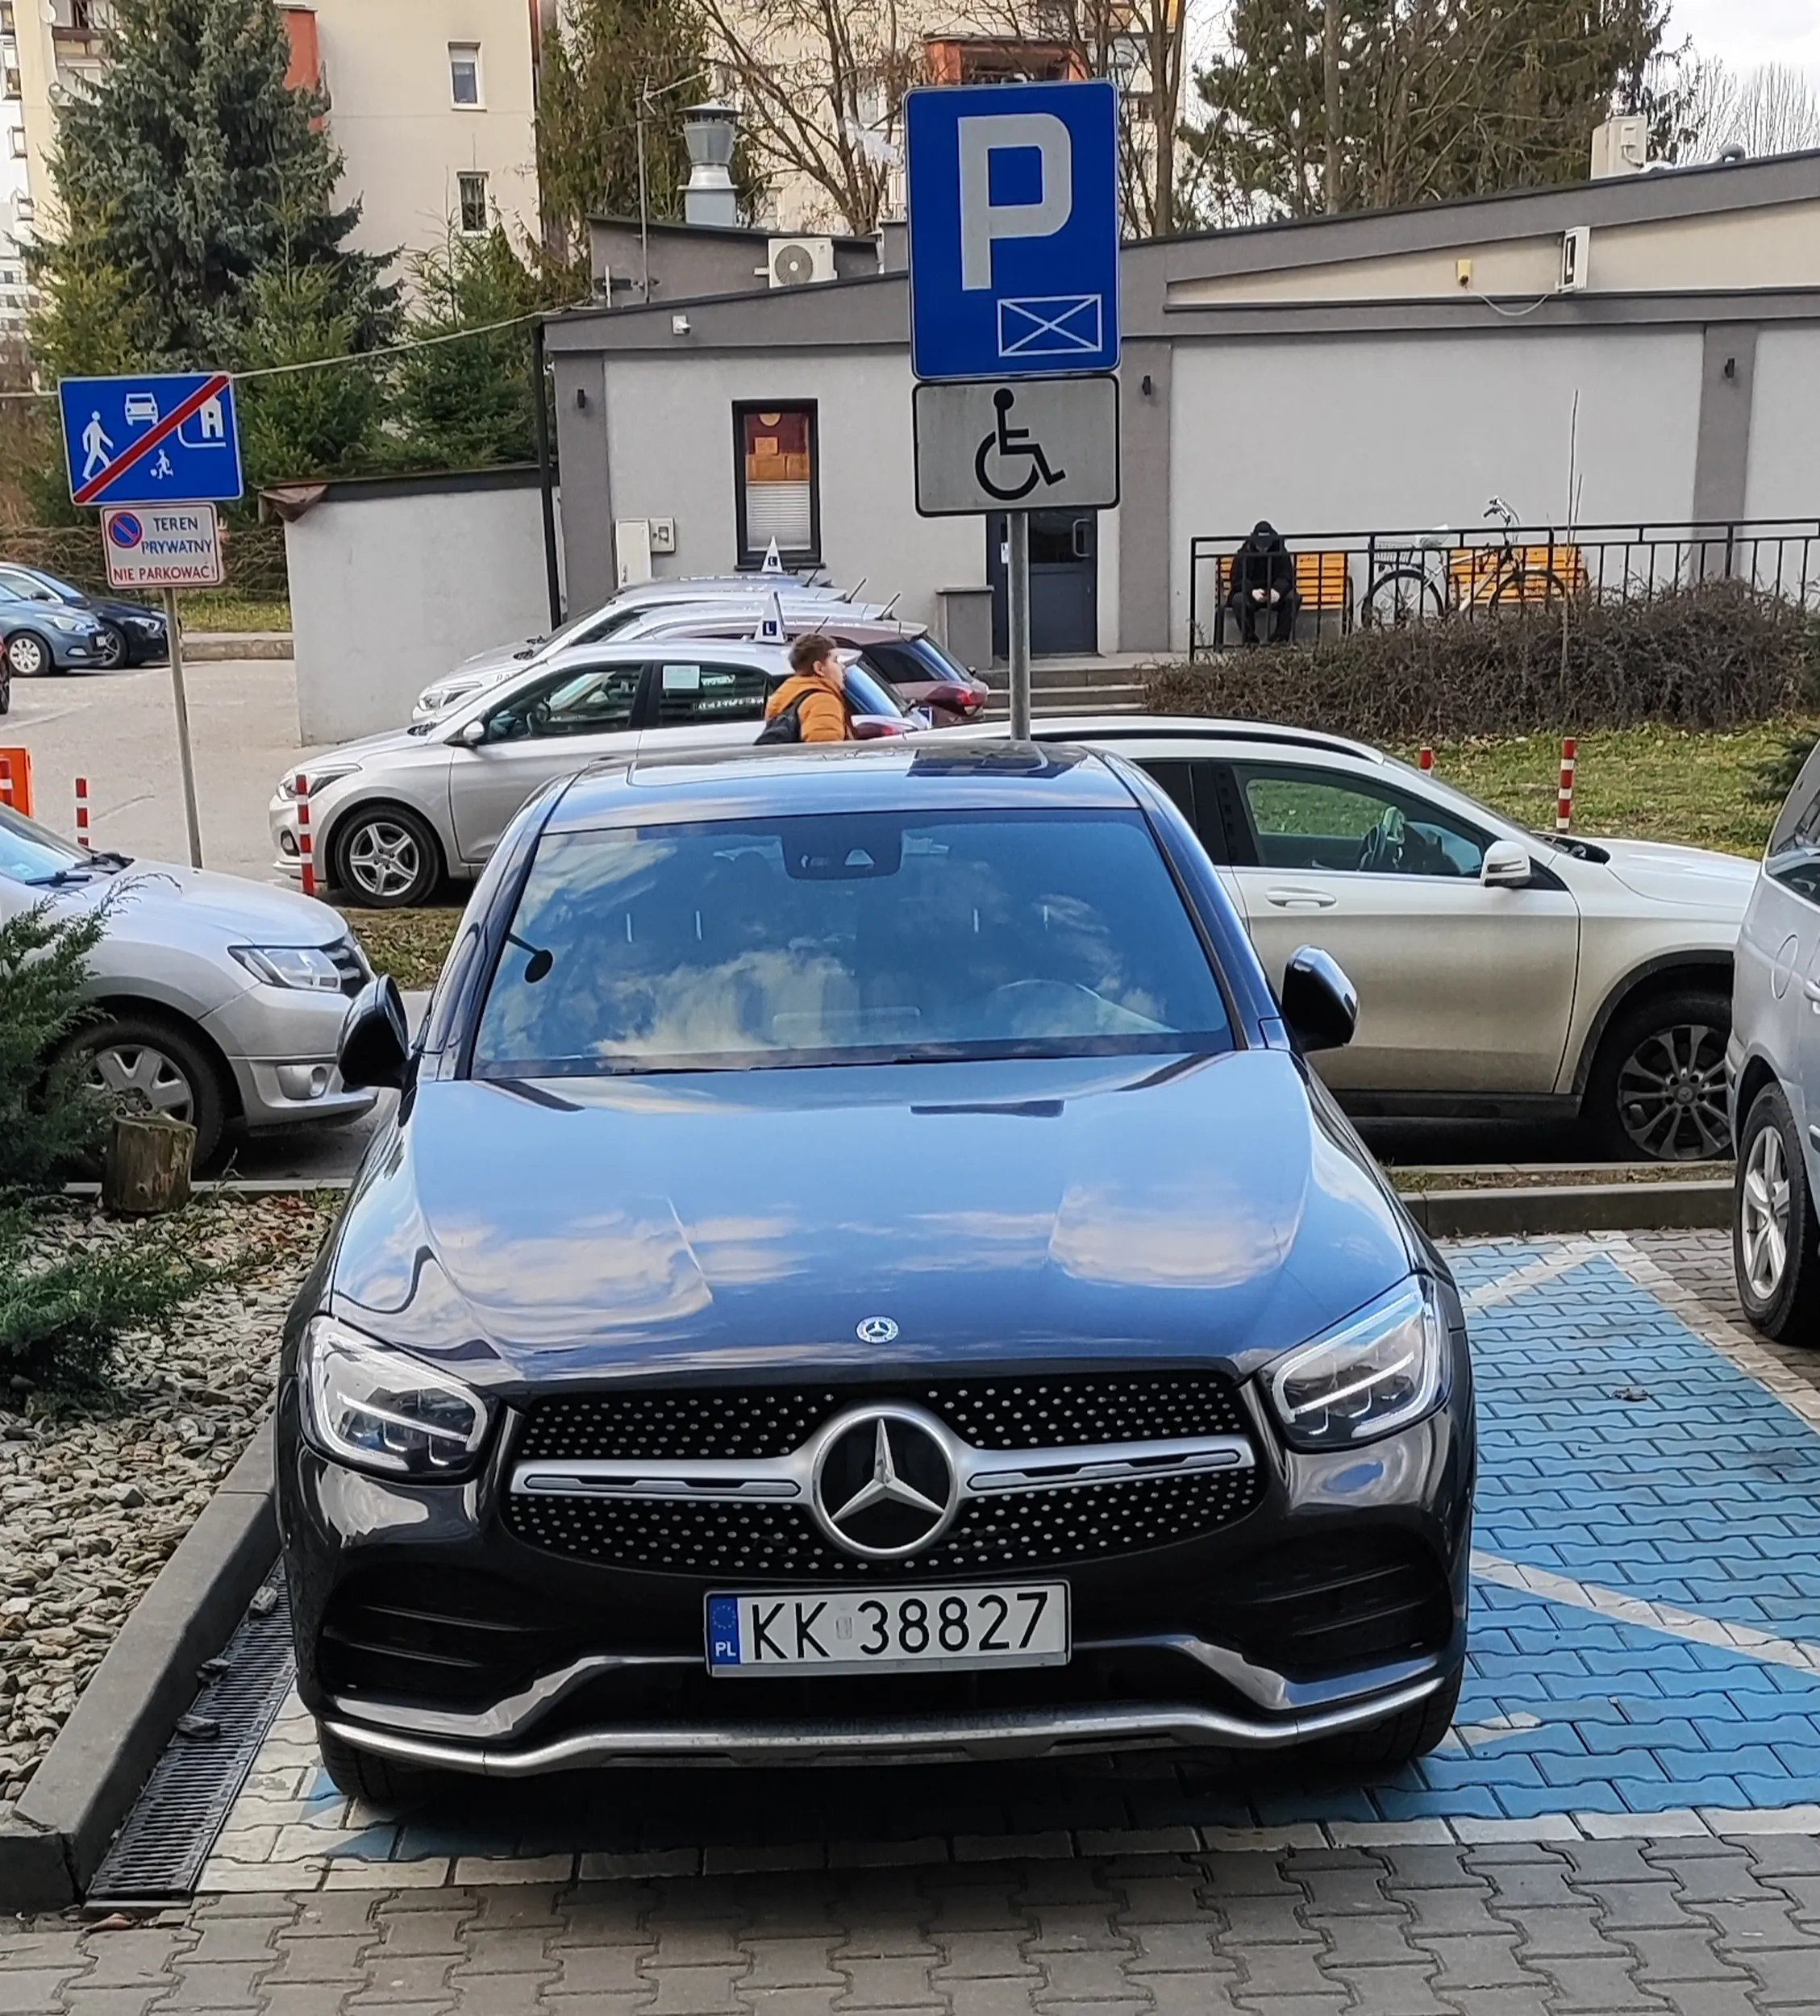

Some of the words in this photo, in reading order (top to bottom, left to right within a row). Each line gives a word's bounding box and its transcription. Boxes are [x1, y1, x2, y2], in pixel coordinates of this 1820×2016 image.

[957, 112, 1072, 291] P
[152, 516, 198, 532] TEREN
[141, 538, 212, 555] PRYWATNY
[113, 567, 135, 581] NIE
[765, 622, 774, 635] L
[751, 1602, 831, 1660] KK
[857, 1591, 1048, 1656] 38827
[715, 1641, 737, 1657] PL
